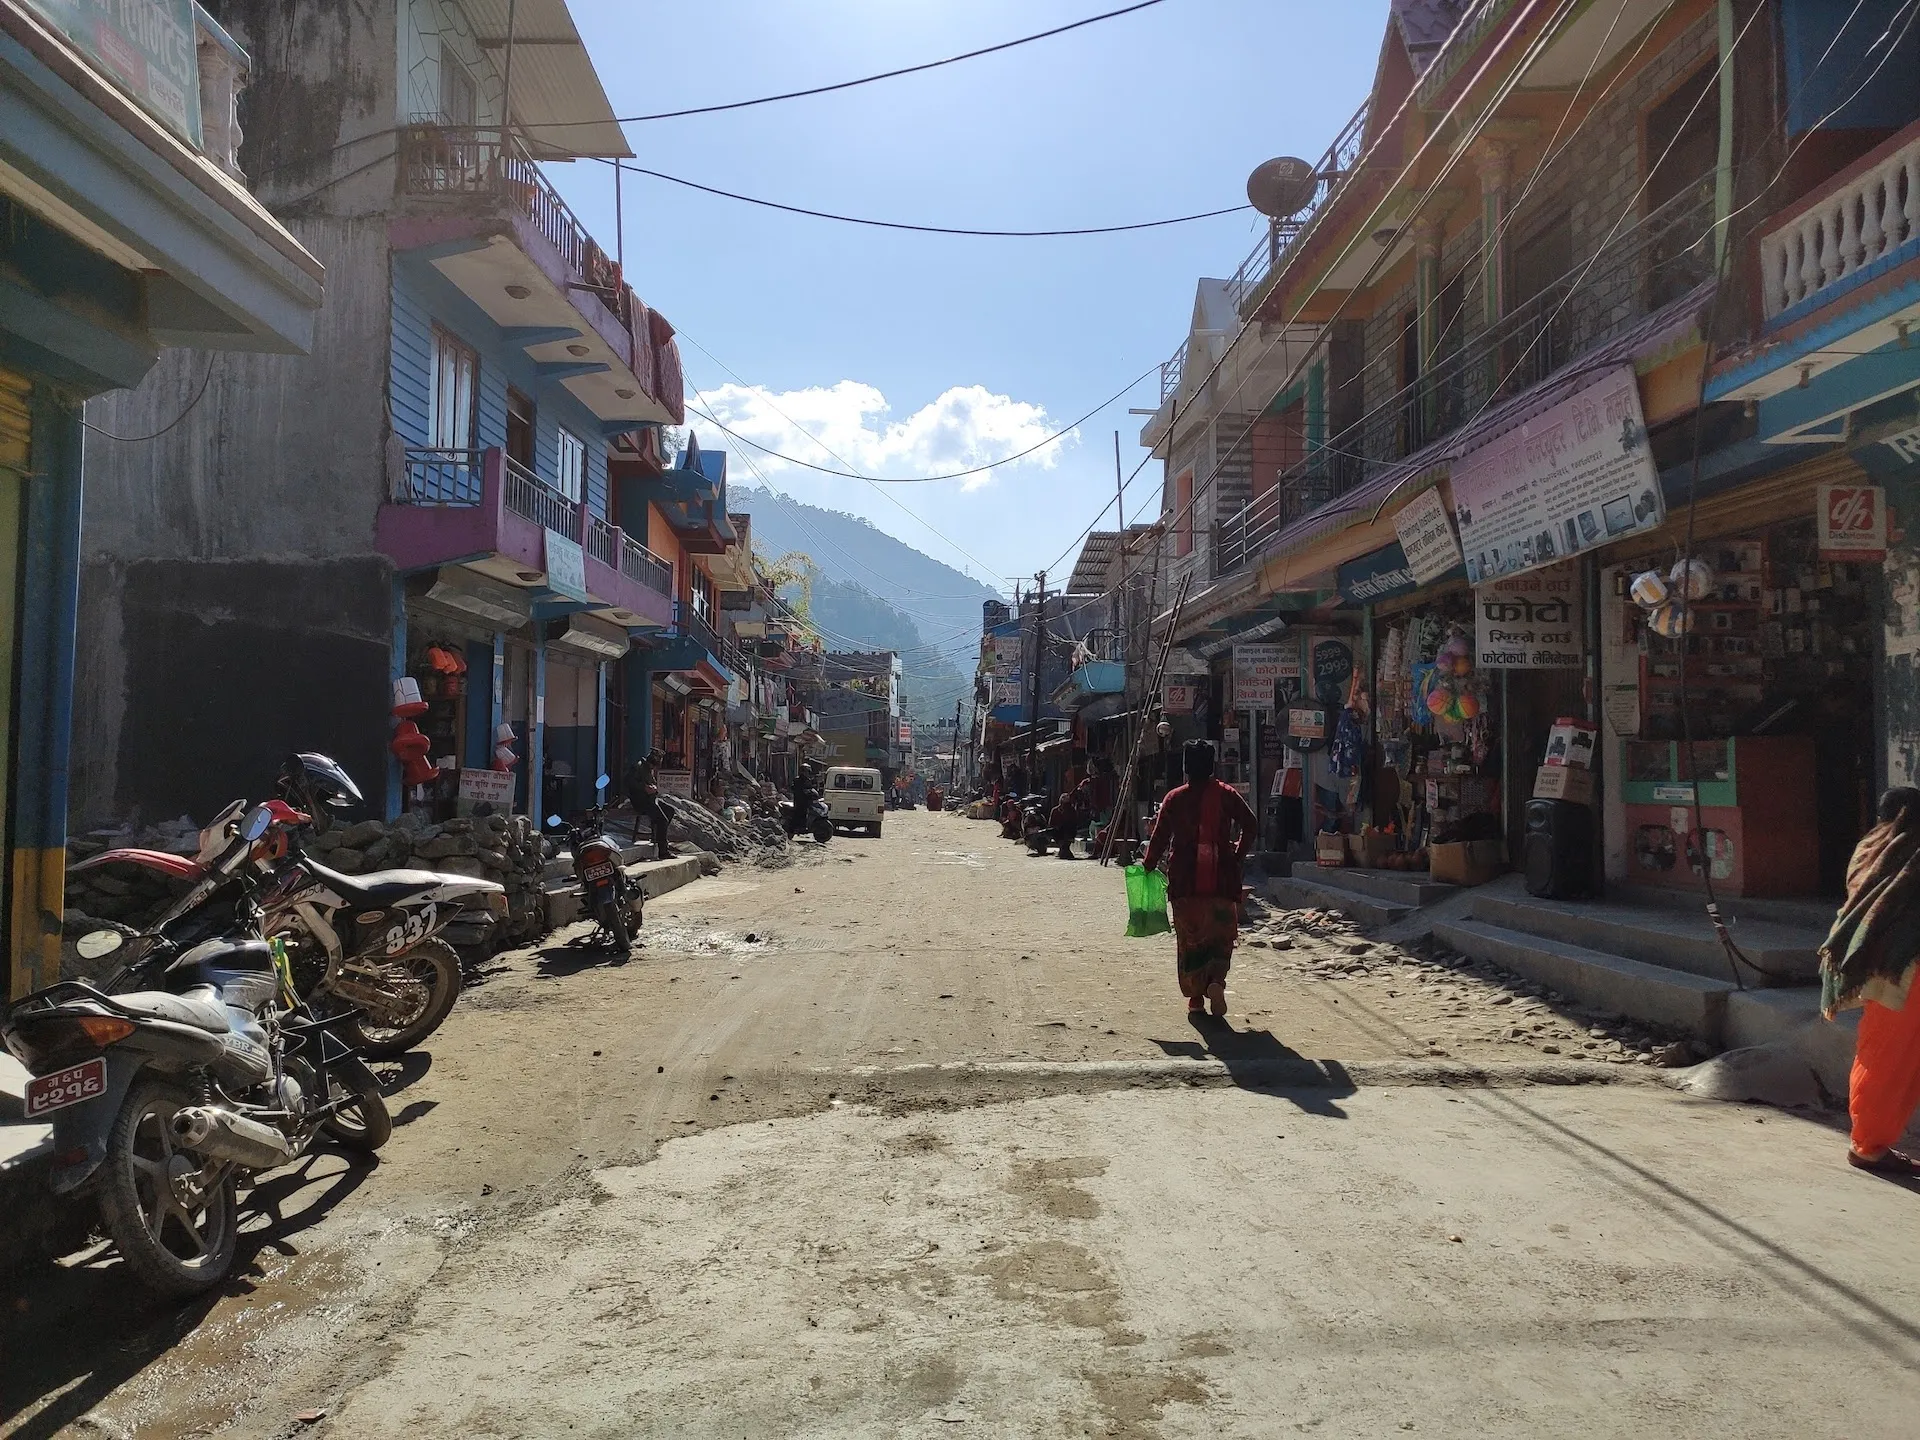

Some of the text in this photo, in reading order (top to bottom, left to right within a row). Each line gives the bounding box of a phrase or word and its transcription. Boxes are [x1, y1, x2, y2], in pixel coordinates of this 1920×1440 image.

[1398, 506, 1442, 541] Training Institute
[1482, 596, 1572, 622] फोटो
[1482, 650, 1527, 664] फोटोकपी
[1255, 664, 1299, 674] फोटो तथा
[1317, 658, 1349, 676] 2999
[386, 902, 437, 954] 837
[223, 1037, 252, 1052] YBR
